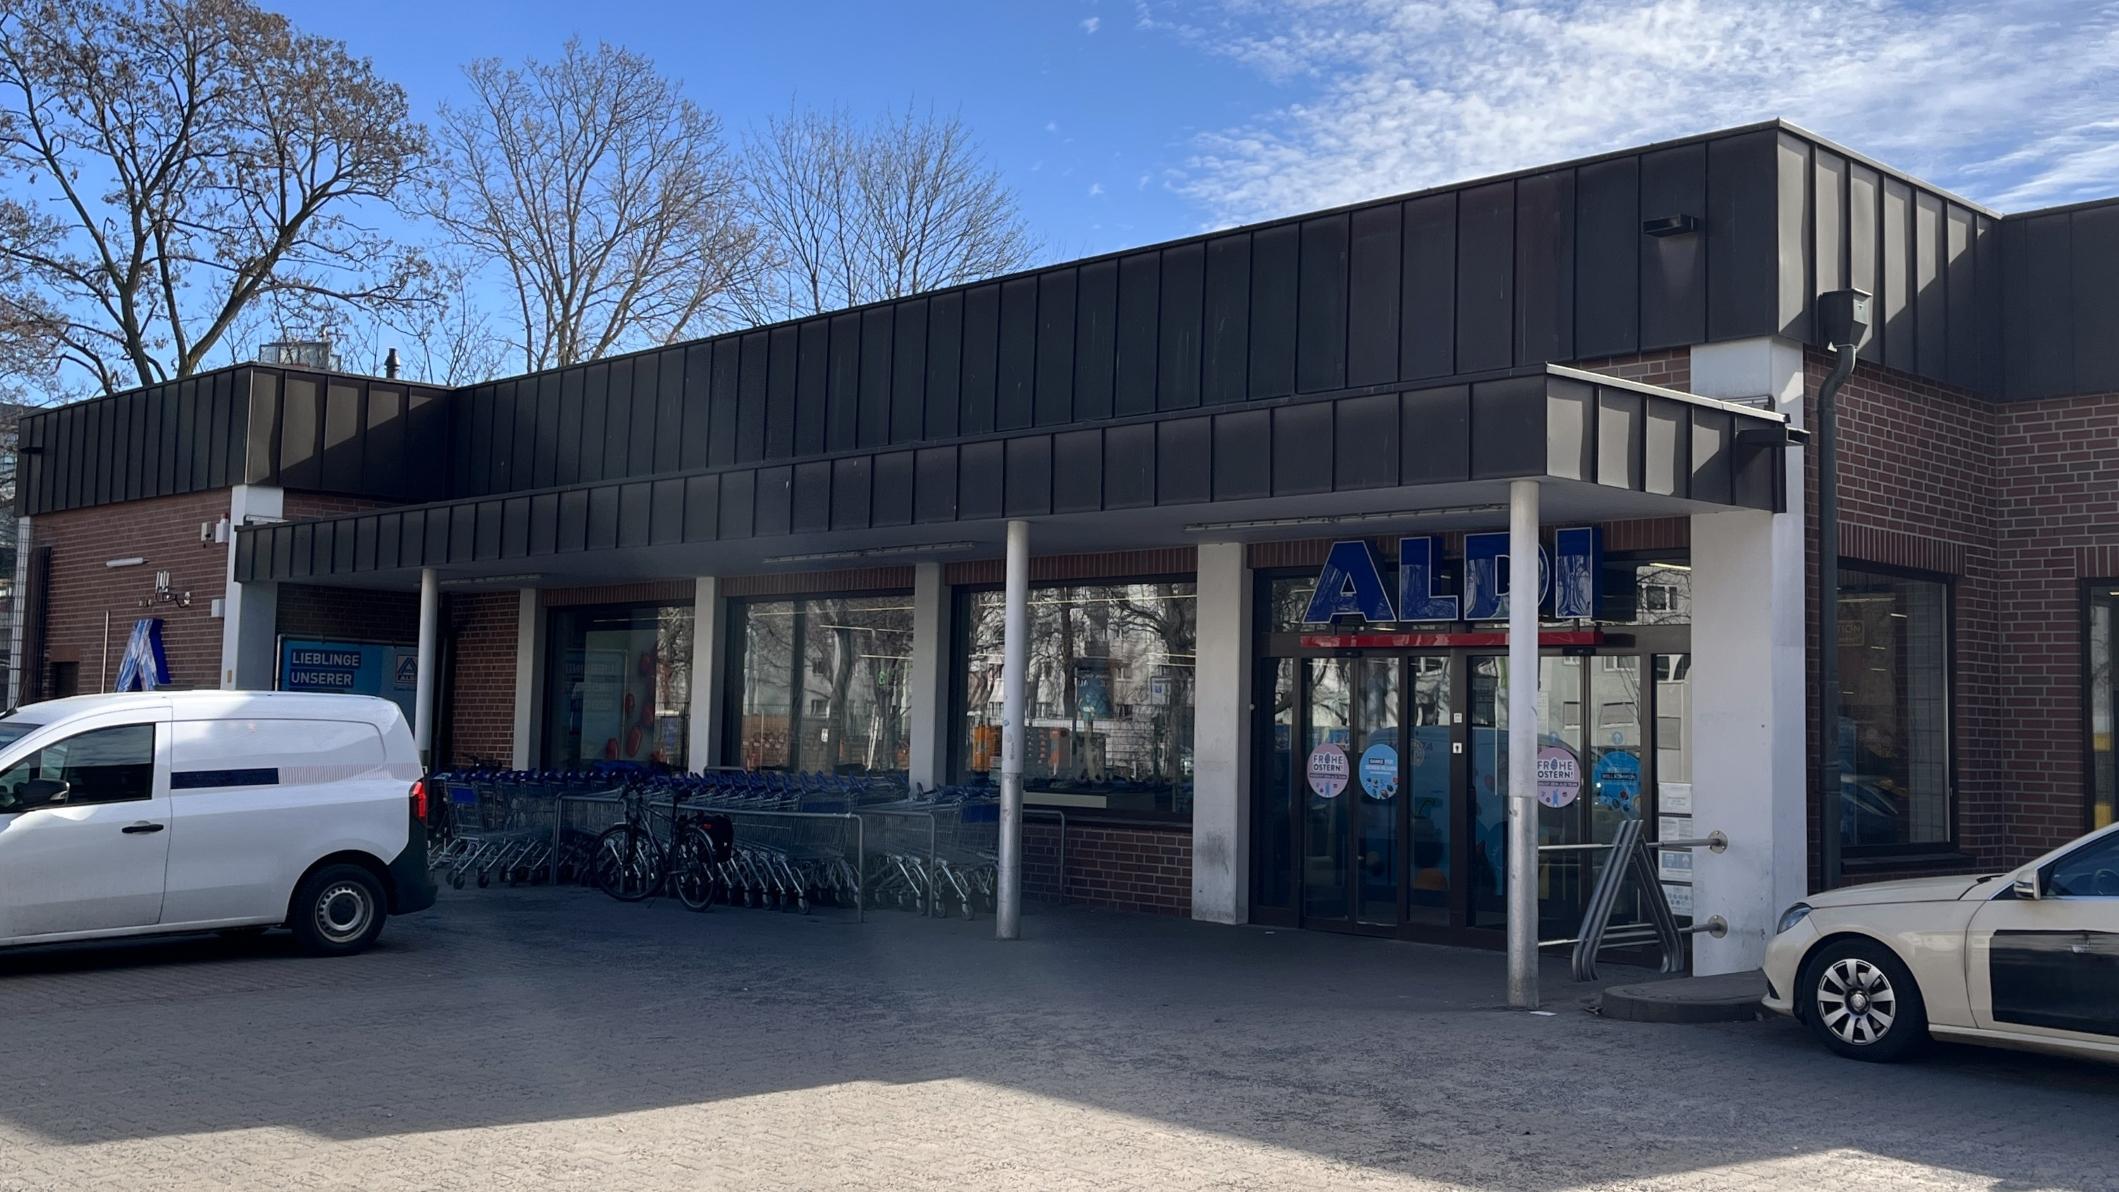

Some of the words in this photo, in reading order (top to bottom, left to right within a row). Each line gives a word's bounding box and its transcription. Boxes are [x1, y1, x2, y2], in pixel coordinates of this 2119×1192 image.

[1301, 527, 1593, 624] ALDI
[292, 651, 360, 667] LIEBLINGE
[291, 671, 353, 686] UNSERER
[1537, 758, 1573, 771] FROHE
[1537, 770, 1574, 779] OSTERN!
